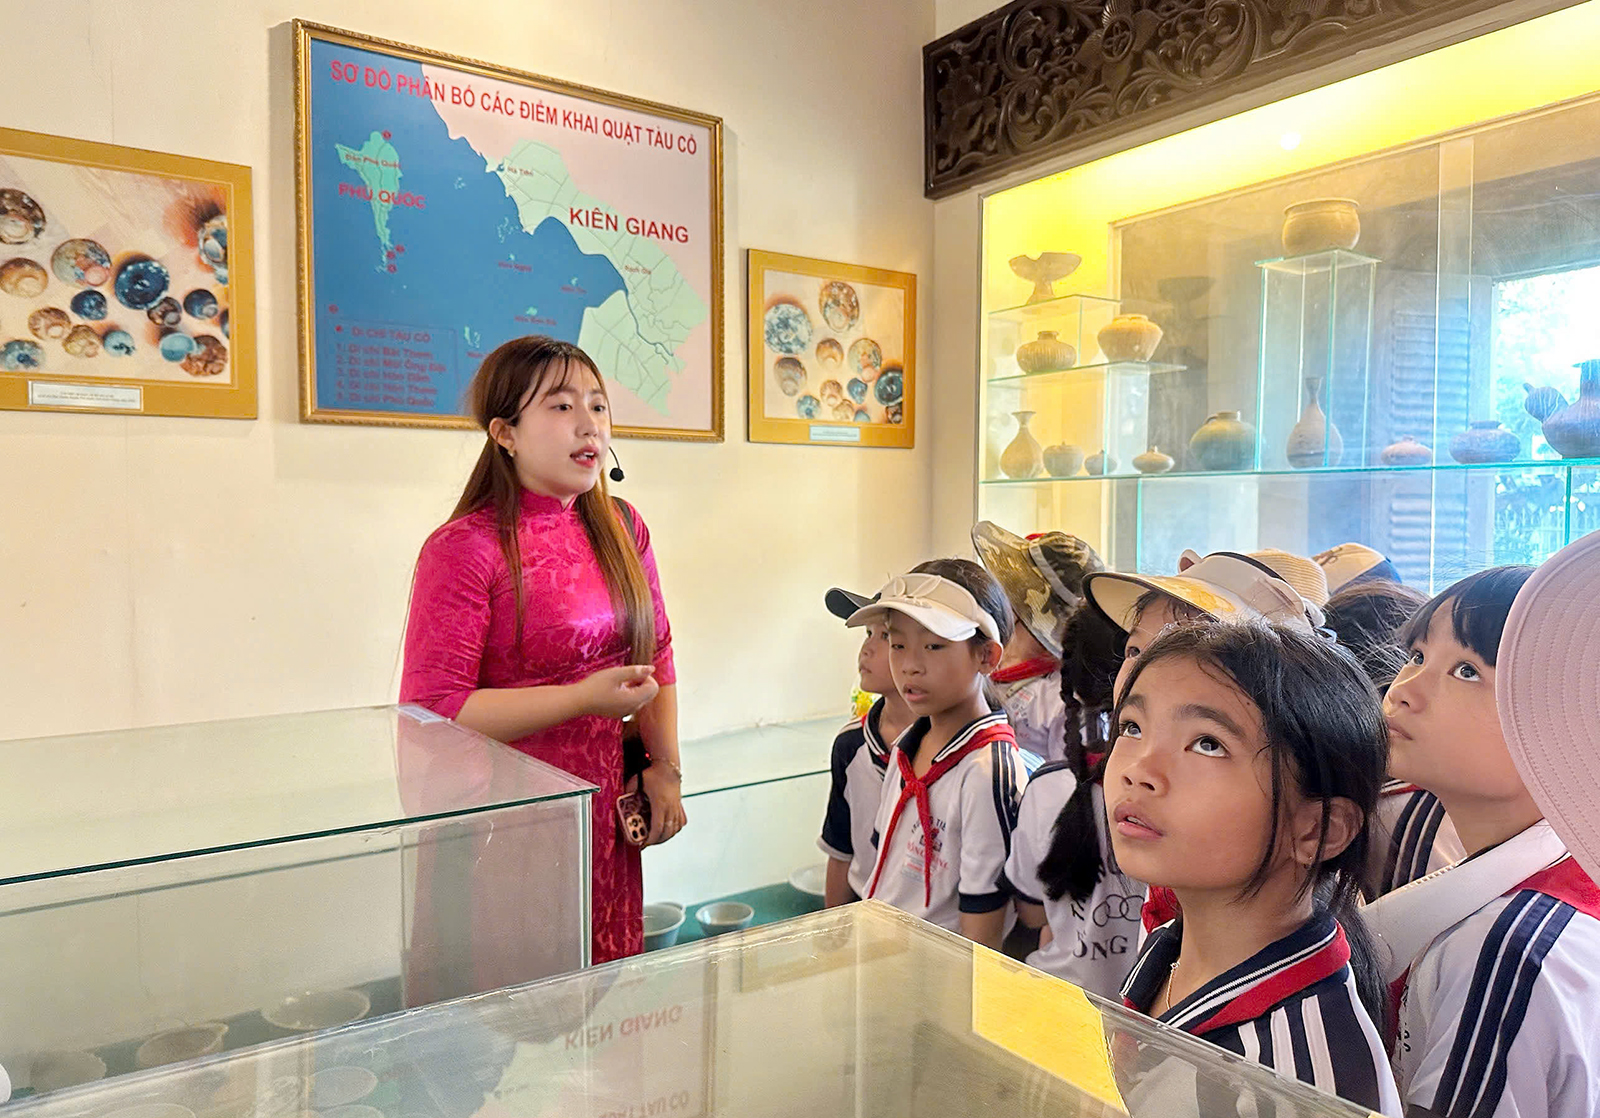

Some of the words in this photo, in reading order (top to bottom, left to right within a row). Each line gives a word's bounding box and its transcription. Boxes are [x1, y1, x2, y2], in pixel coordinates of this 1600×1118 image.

[480, 90, 514, 116] CÁC
[562, 109, 598, 134] KHAI
[569, 207, 618, 232] KIÊN
[625, 217, 689, 243] GIANG
